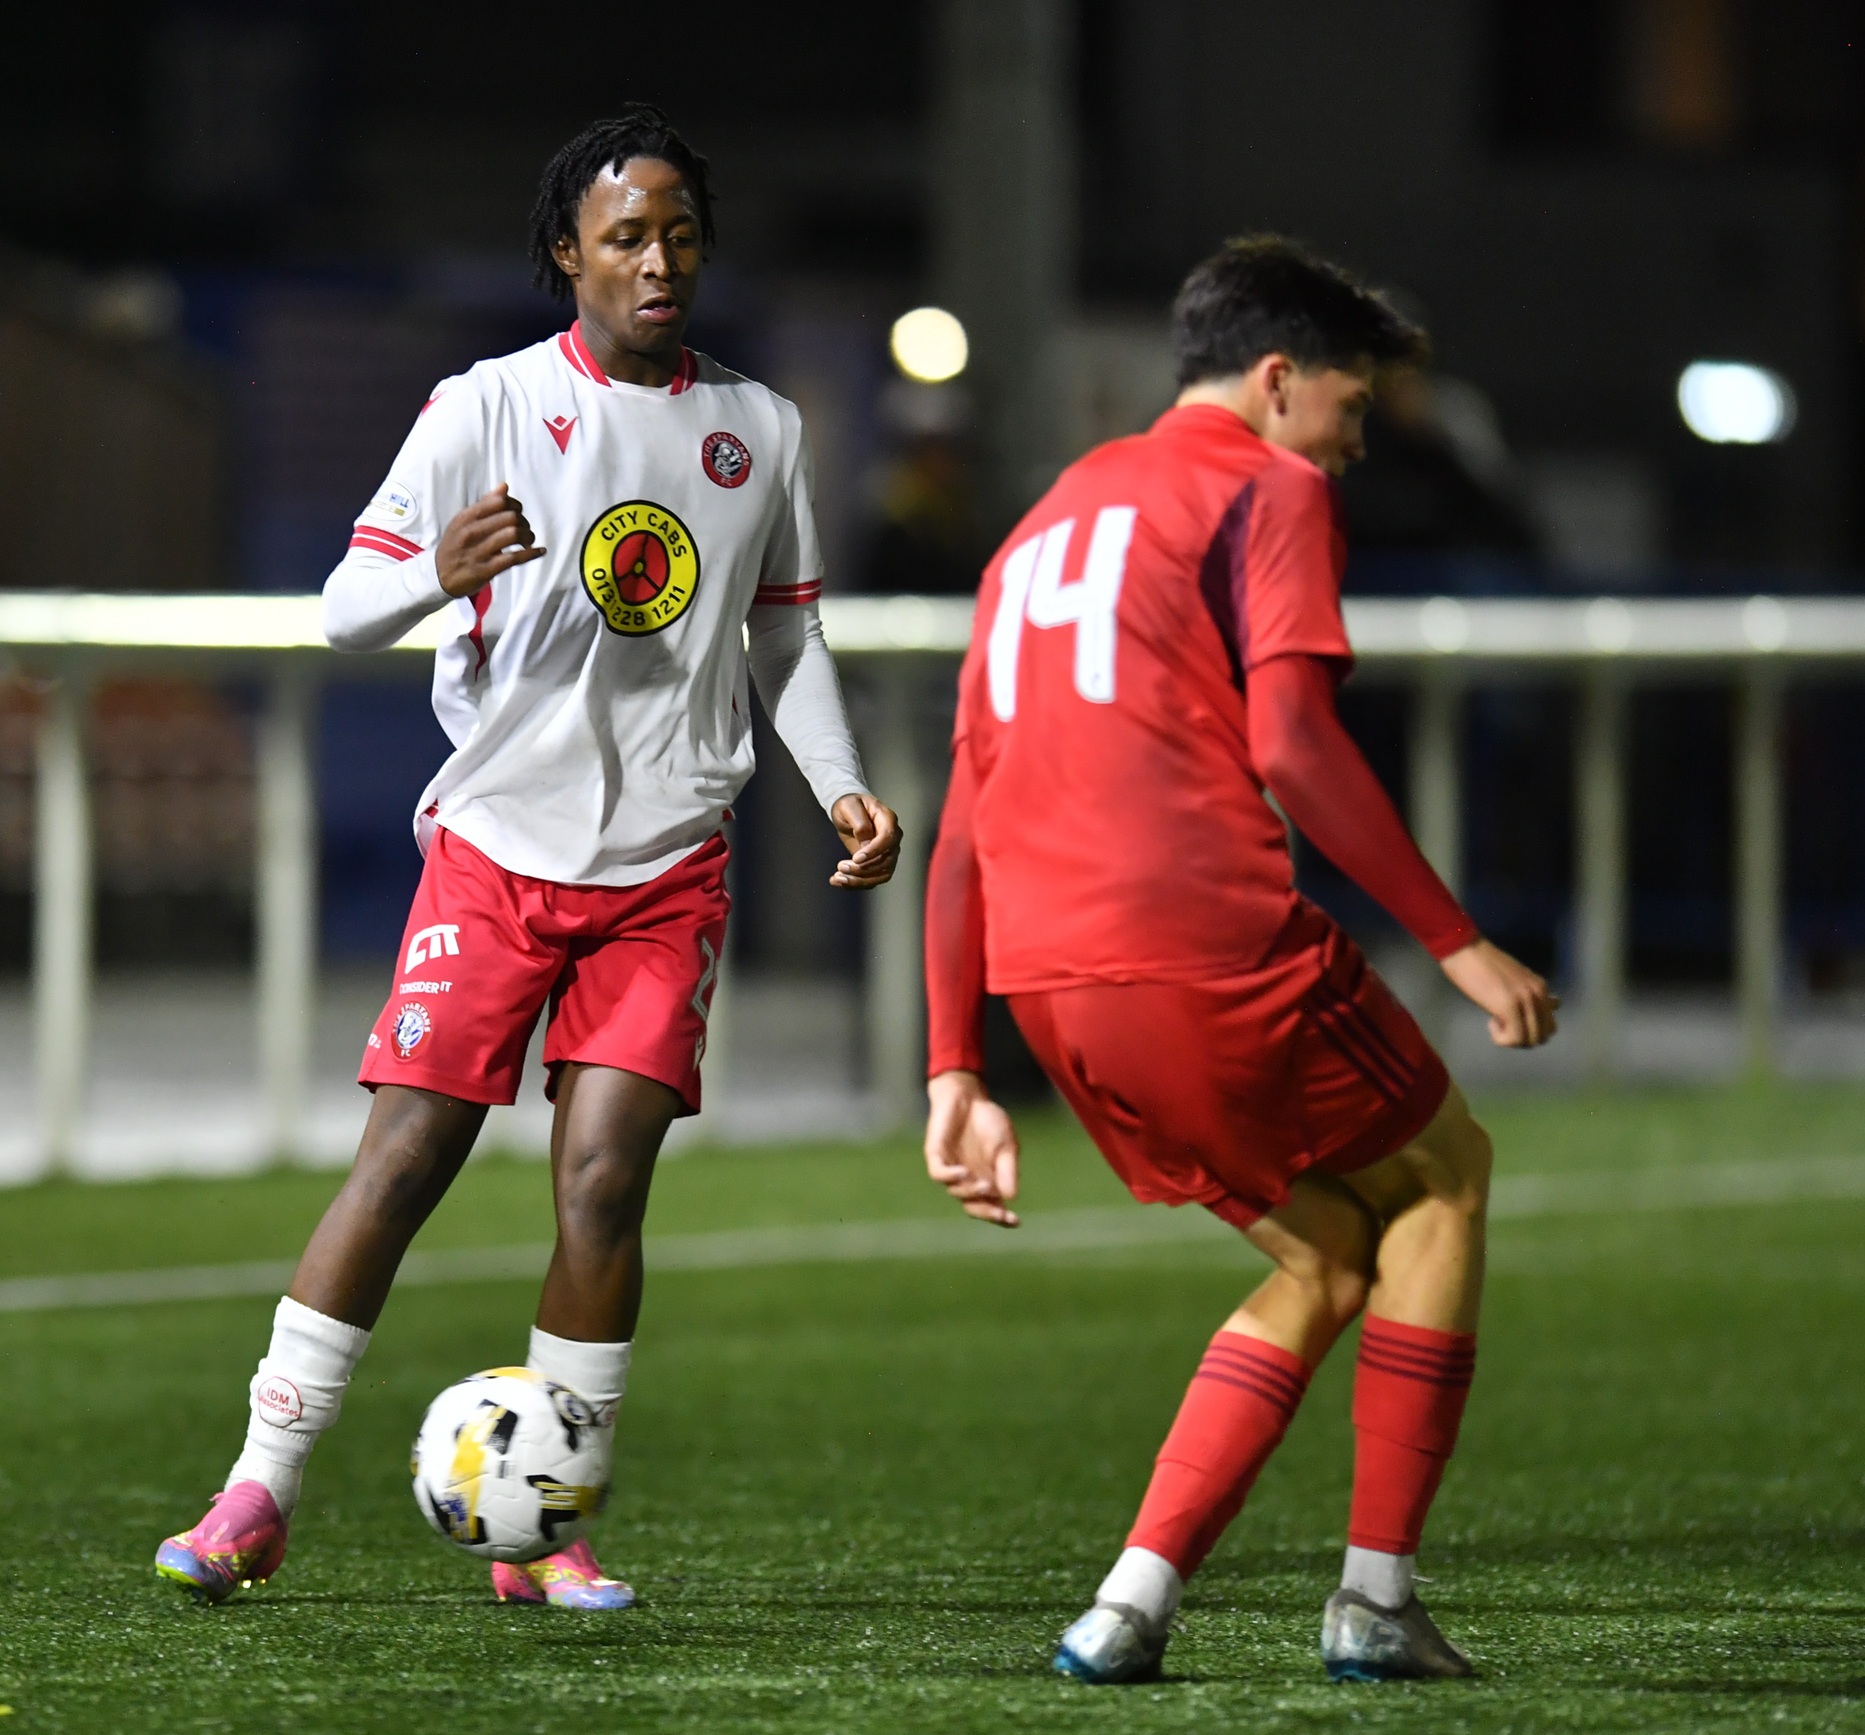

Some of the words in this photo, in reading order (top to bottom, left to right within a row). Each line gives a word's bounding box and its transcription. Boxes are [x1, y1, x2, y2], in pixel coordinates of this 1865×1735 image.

[601, 510, 638, 541] CITY
[647, 512, 687, 558] CABS
[612, 606, 646, 626] 228
[652, 585, 686, 620] 1211
[987, 505, 1138, 723] 14
[400, 1049, 411, 1058] FC
[267, 1387, 289, 1406] IDM
